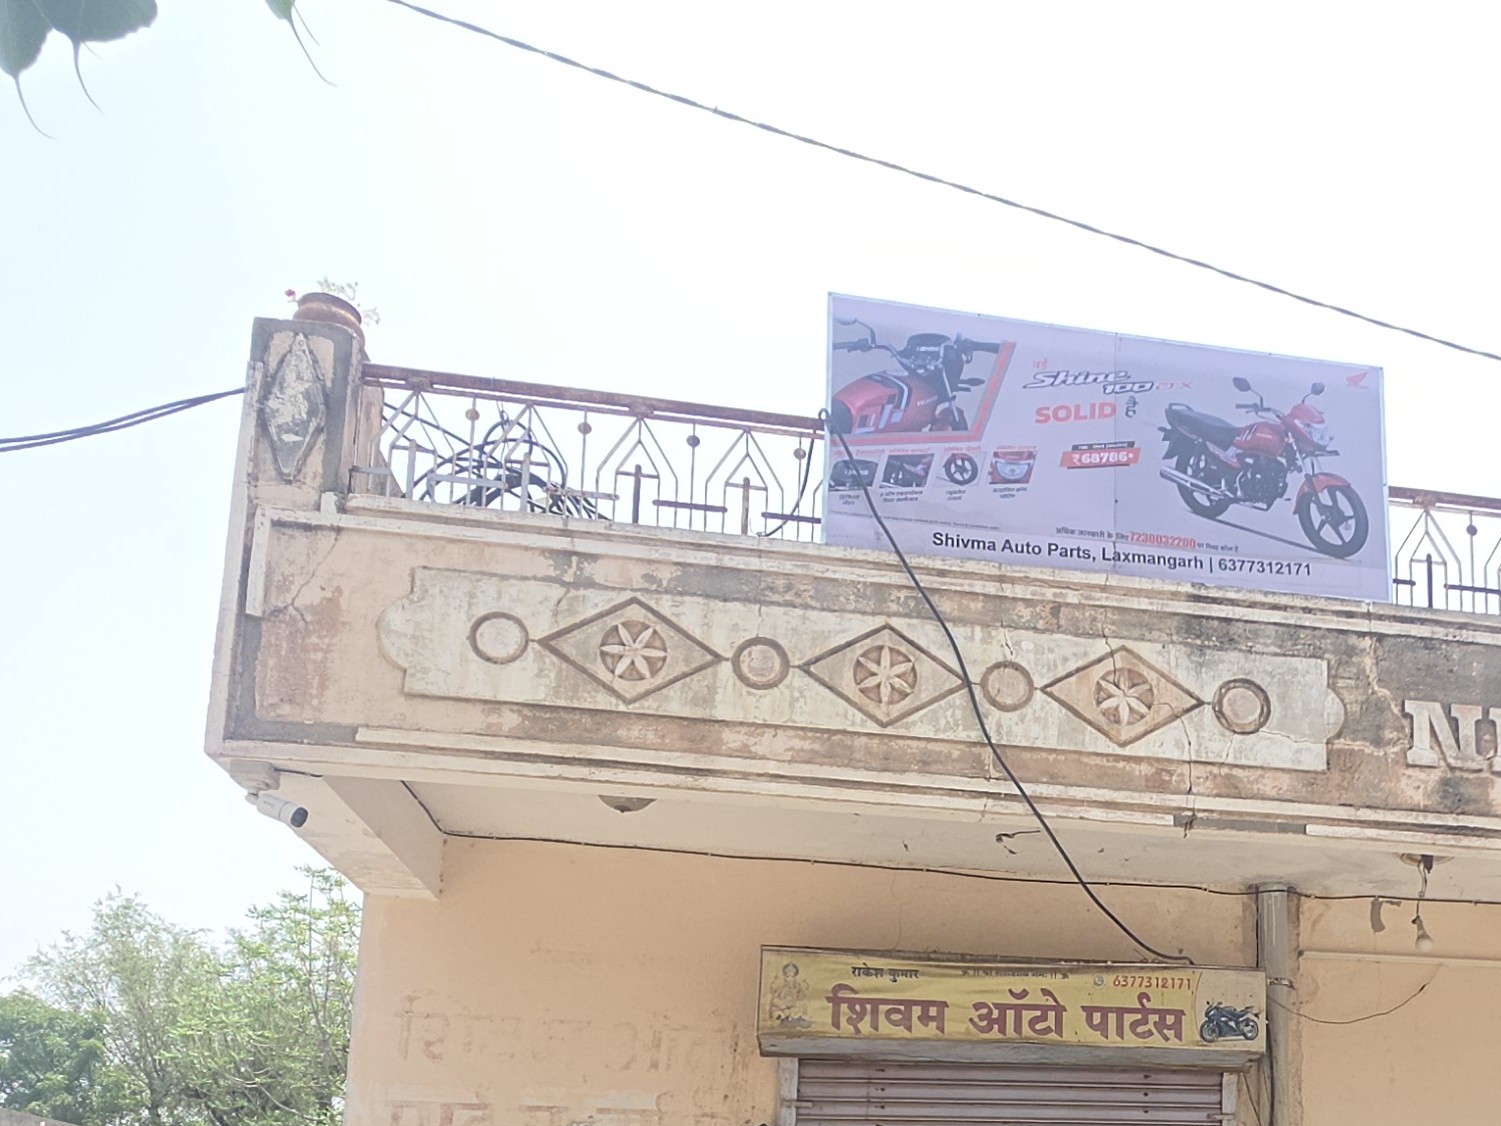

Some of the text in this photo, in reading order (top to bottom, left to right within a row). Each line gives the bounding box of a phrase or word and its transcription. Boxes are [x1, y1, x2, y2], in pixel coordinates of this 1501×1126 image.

[1022, 370, 1131, 389] Shine
[1102, 381, 1154, 395] 100
[1034, 396, 1139, 424] SOLID है
[1130, 531, 1197, 550] 7230032200
[932, 532, 996, 551] Shivma
[1001, 539, 1042, 555] Auto
[1048, 543, 1097, 563] Parts,
[1102, 547, 1204, 570] Laxmangarh
[1218, 558, 1311, 576] 6377312171
[851, 962, 919, 982] राकेश कुमार
[1113, 975, 1191, 990] 6377312171
[824, 983, 949, 1035] शिवम
[968, 988, 1067, 1038] ऑटो
